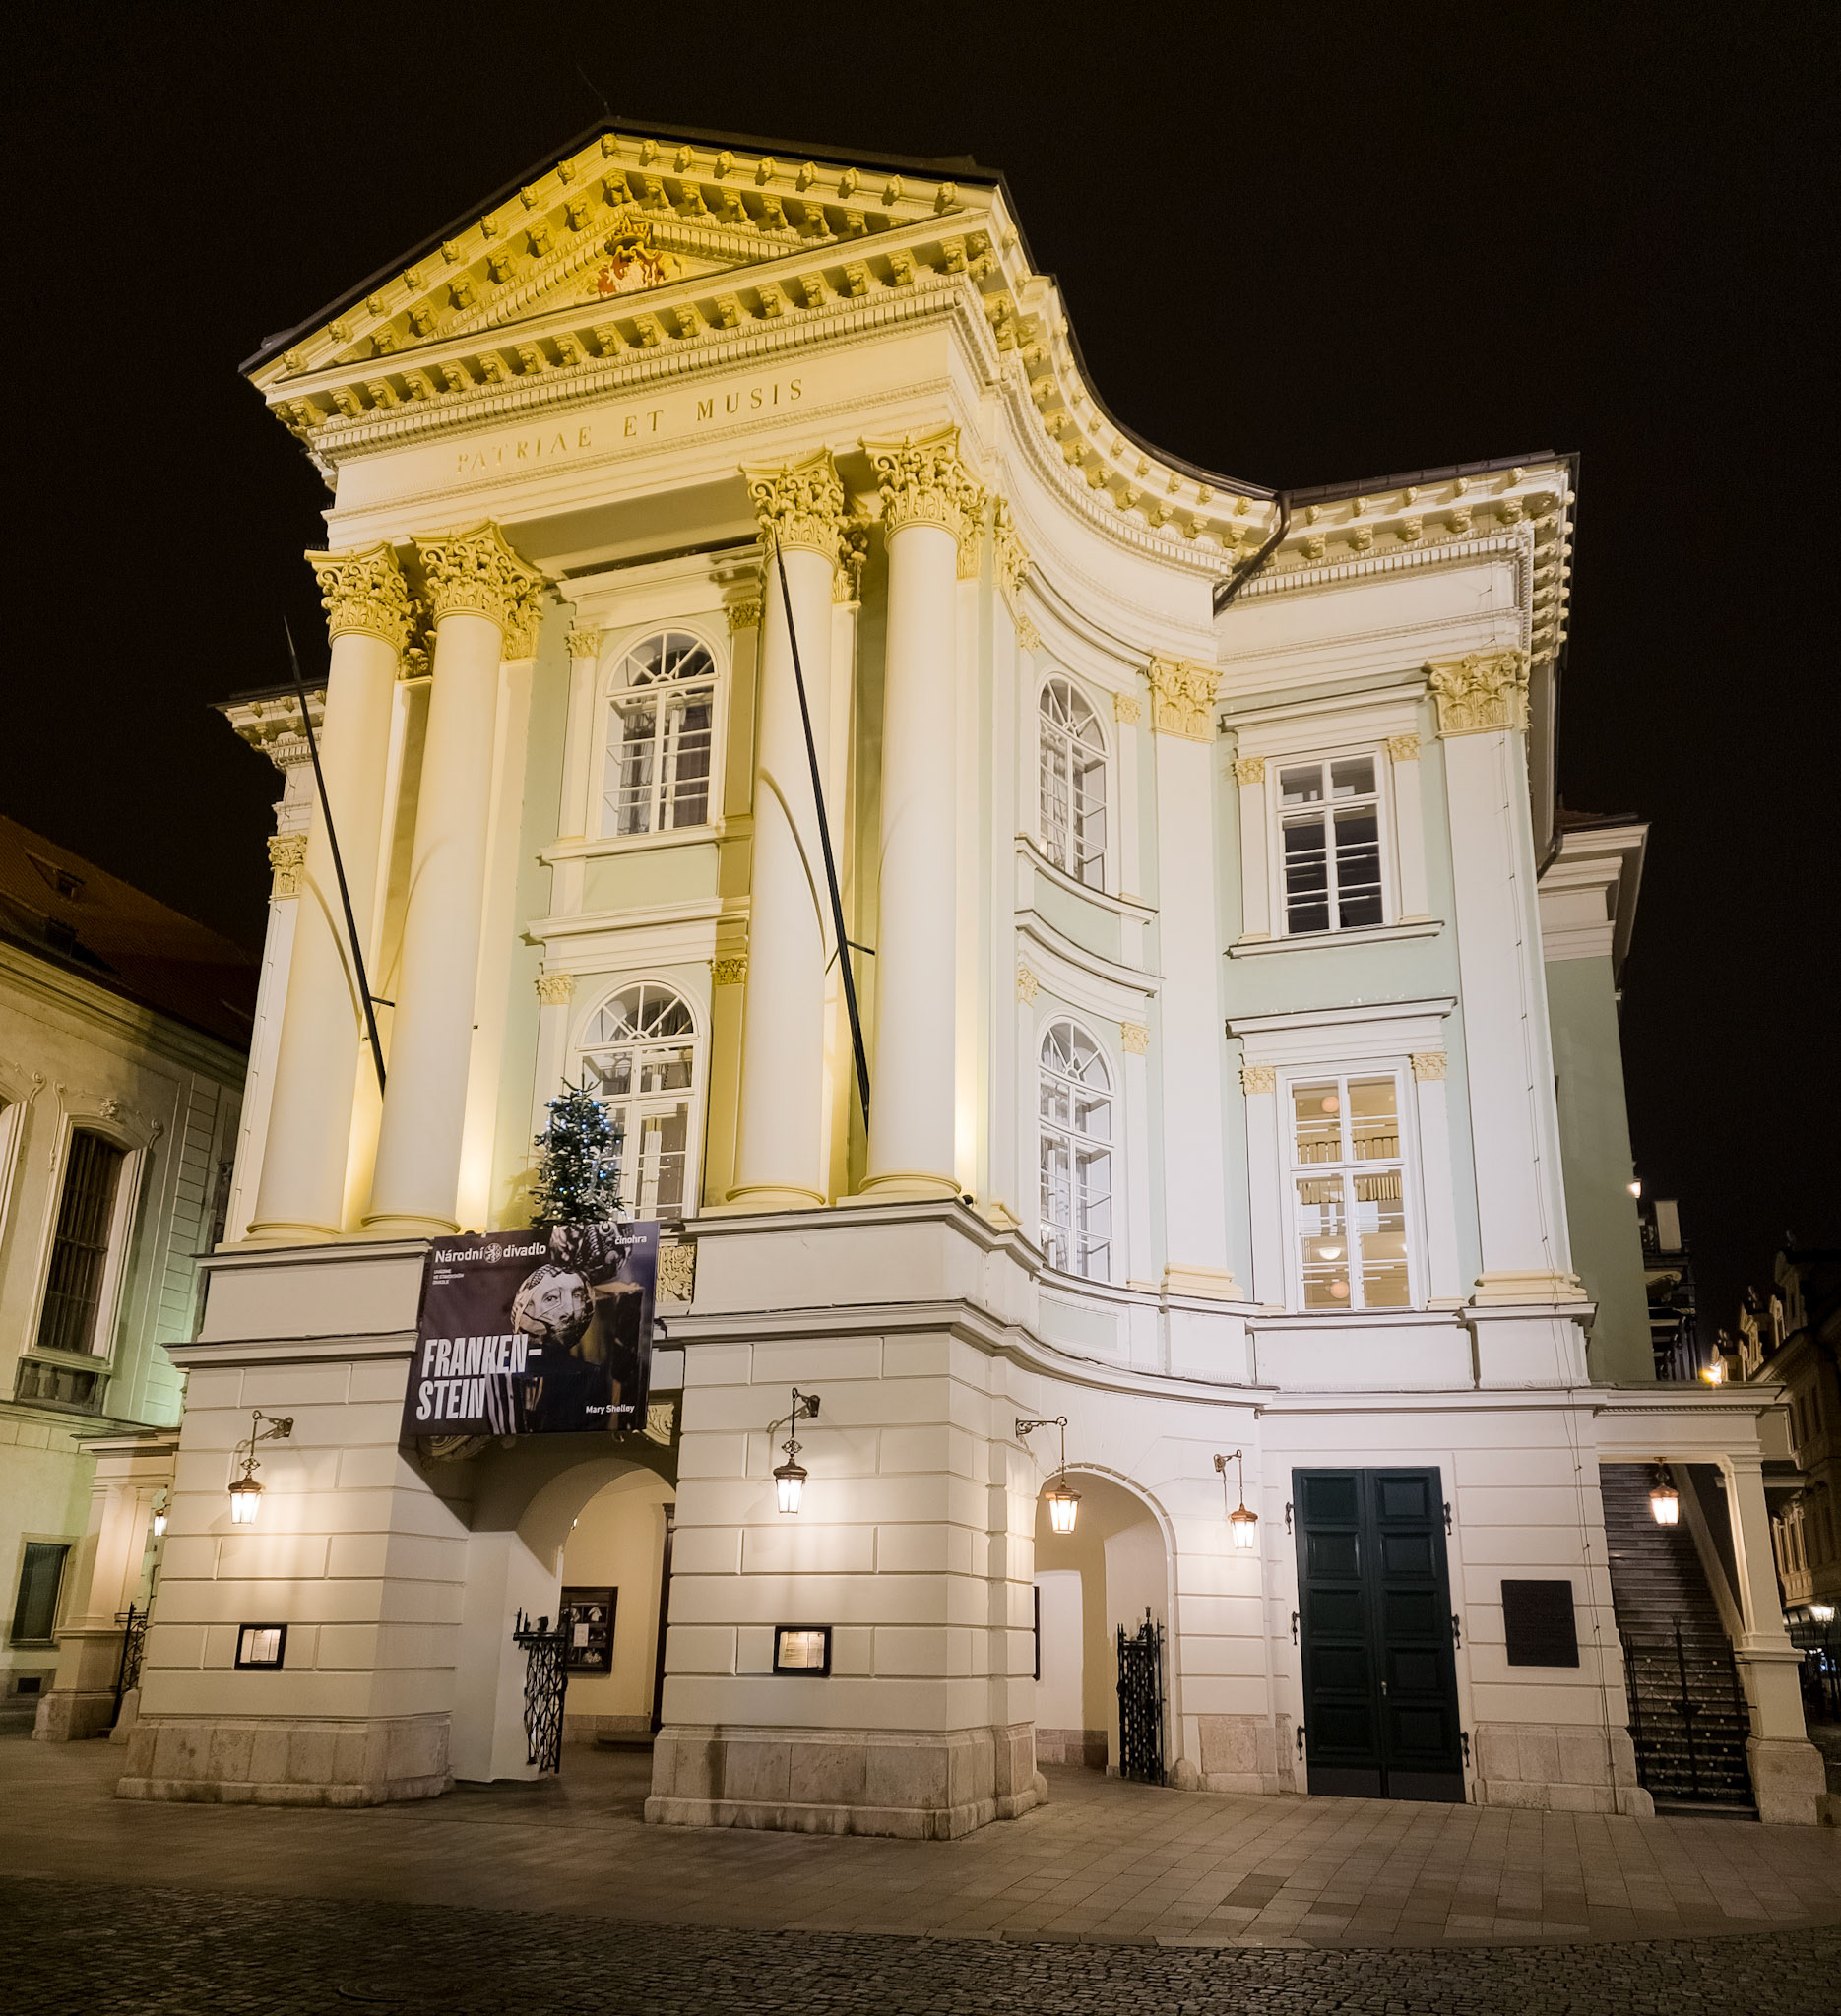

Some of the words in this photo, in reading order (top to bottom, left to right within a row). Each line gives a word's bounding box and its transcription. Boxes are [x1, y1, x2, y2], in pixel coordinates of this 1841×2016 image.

[457, 425, 592, 473] PATRIAE
[623, 410, 664, 437] ET
[697, 379, 802, 421] MUSIS
[435, 1247, 483, 1263] Národní
[502, 1244, 546, 1258] divadlo
[421, 1334, 541, 1377] FRANKEN-
[416, 1378, 485, 1420] STEIN
[586, 1405, 605, 1415] Mary
[606, 1404, 635, 1414] Shelley
